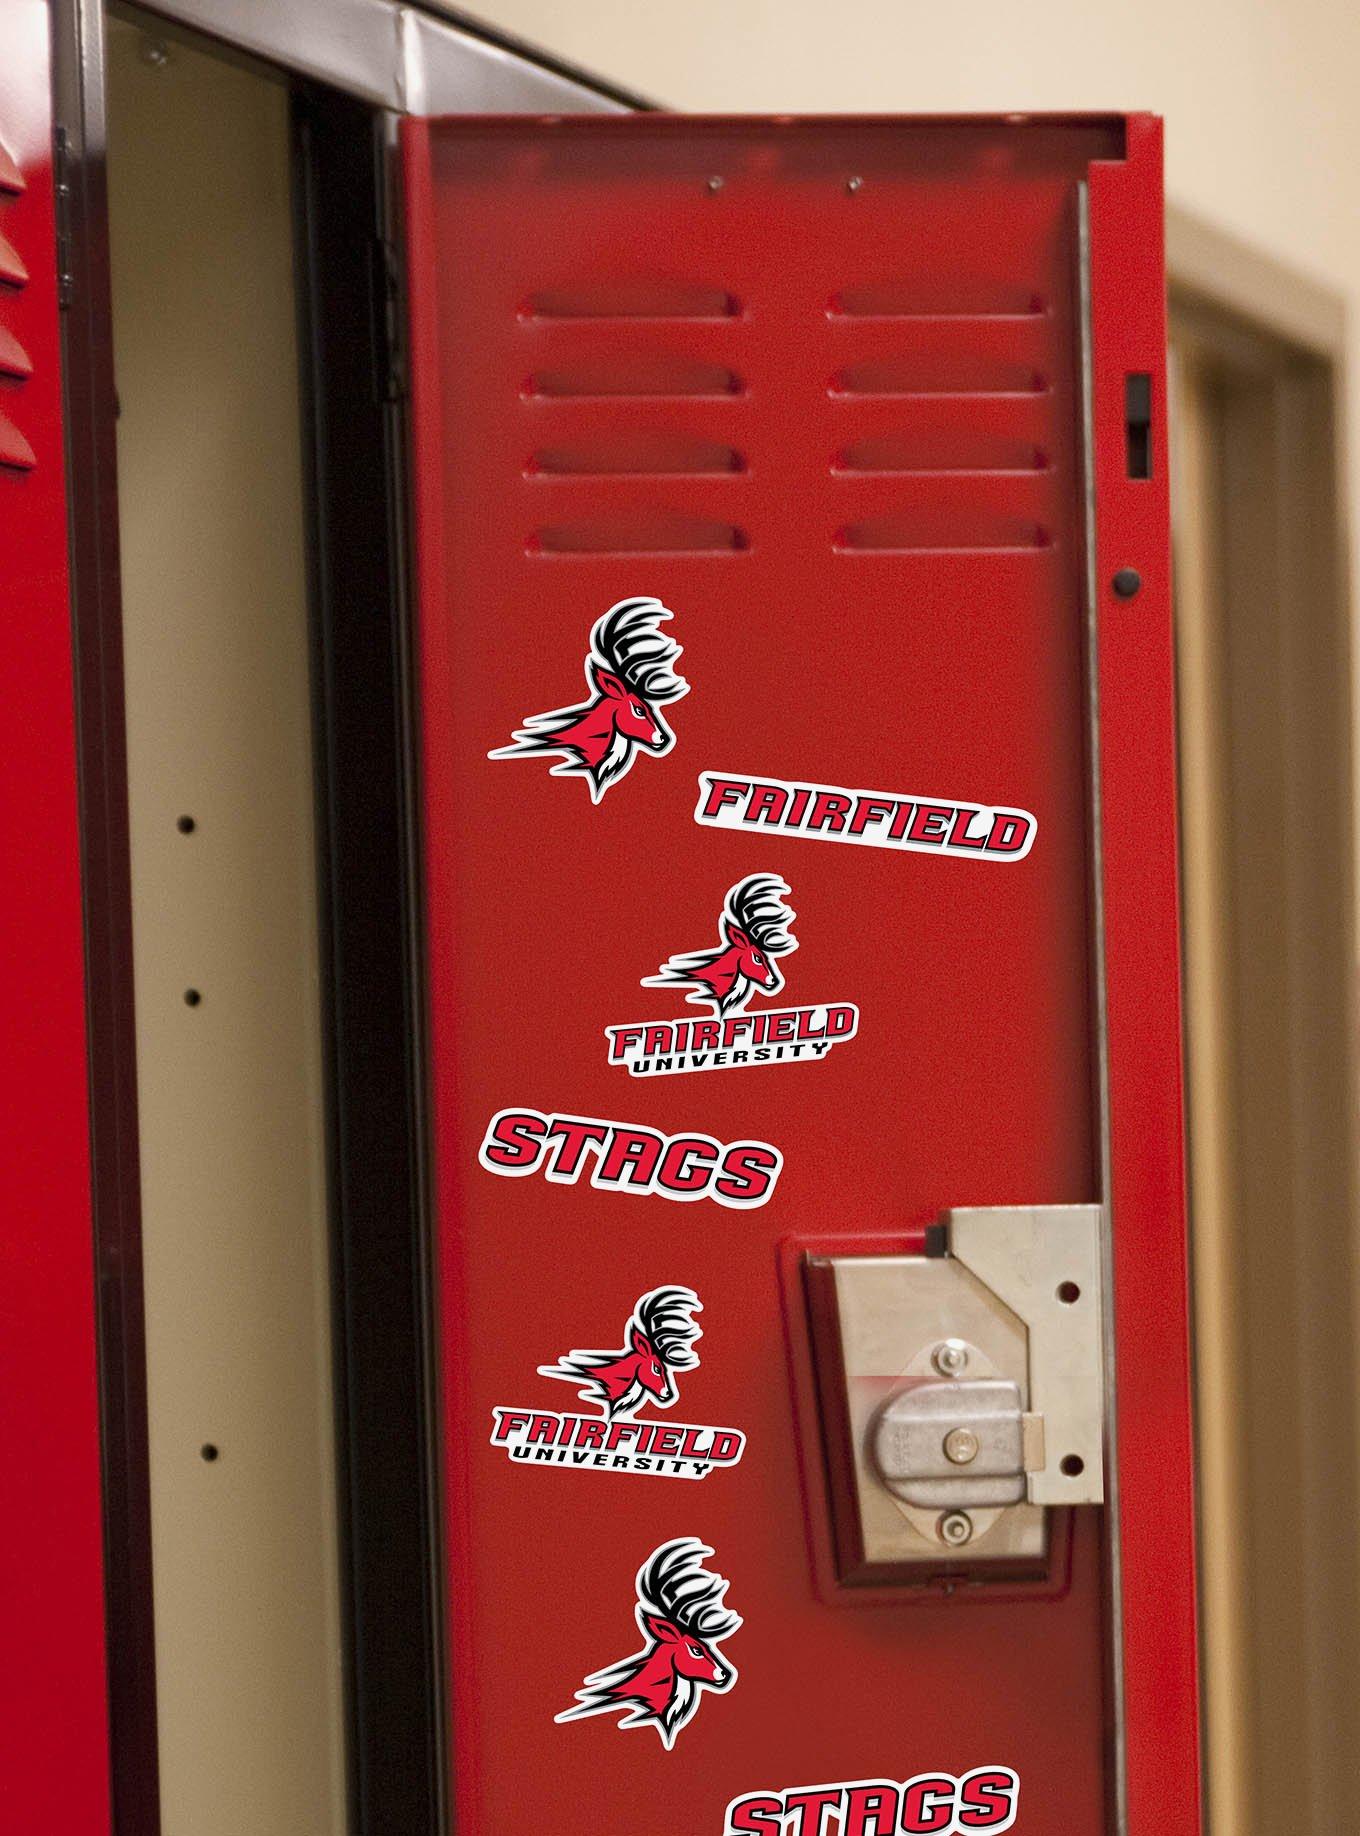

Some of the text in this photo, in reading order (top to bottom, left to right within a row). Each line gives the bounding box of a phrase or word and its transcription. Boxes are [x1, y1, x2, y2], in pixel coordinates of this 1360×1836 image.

[702, 778, 1030, 854] FAIRFIELD
[610, 1007, 855, 1060] FAIRFIELD
[633, 1042, 829, 1073] UNIVERSITY
[485, 1114, 778, 1201] STAGS
[495, 1411, 742, 1461] FAIRFIELD
[513, 1446, 709, 1475] UNIVERSITY
[731, 1772, 1014, 1836] STAGS
